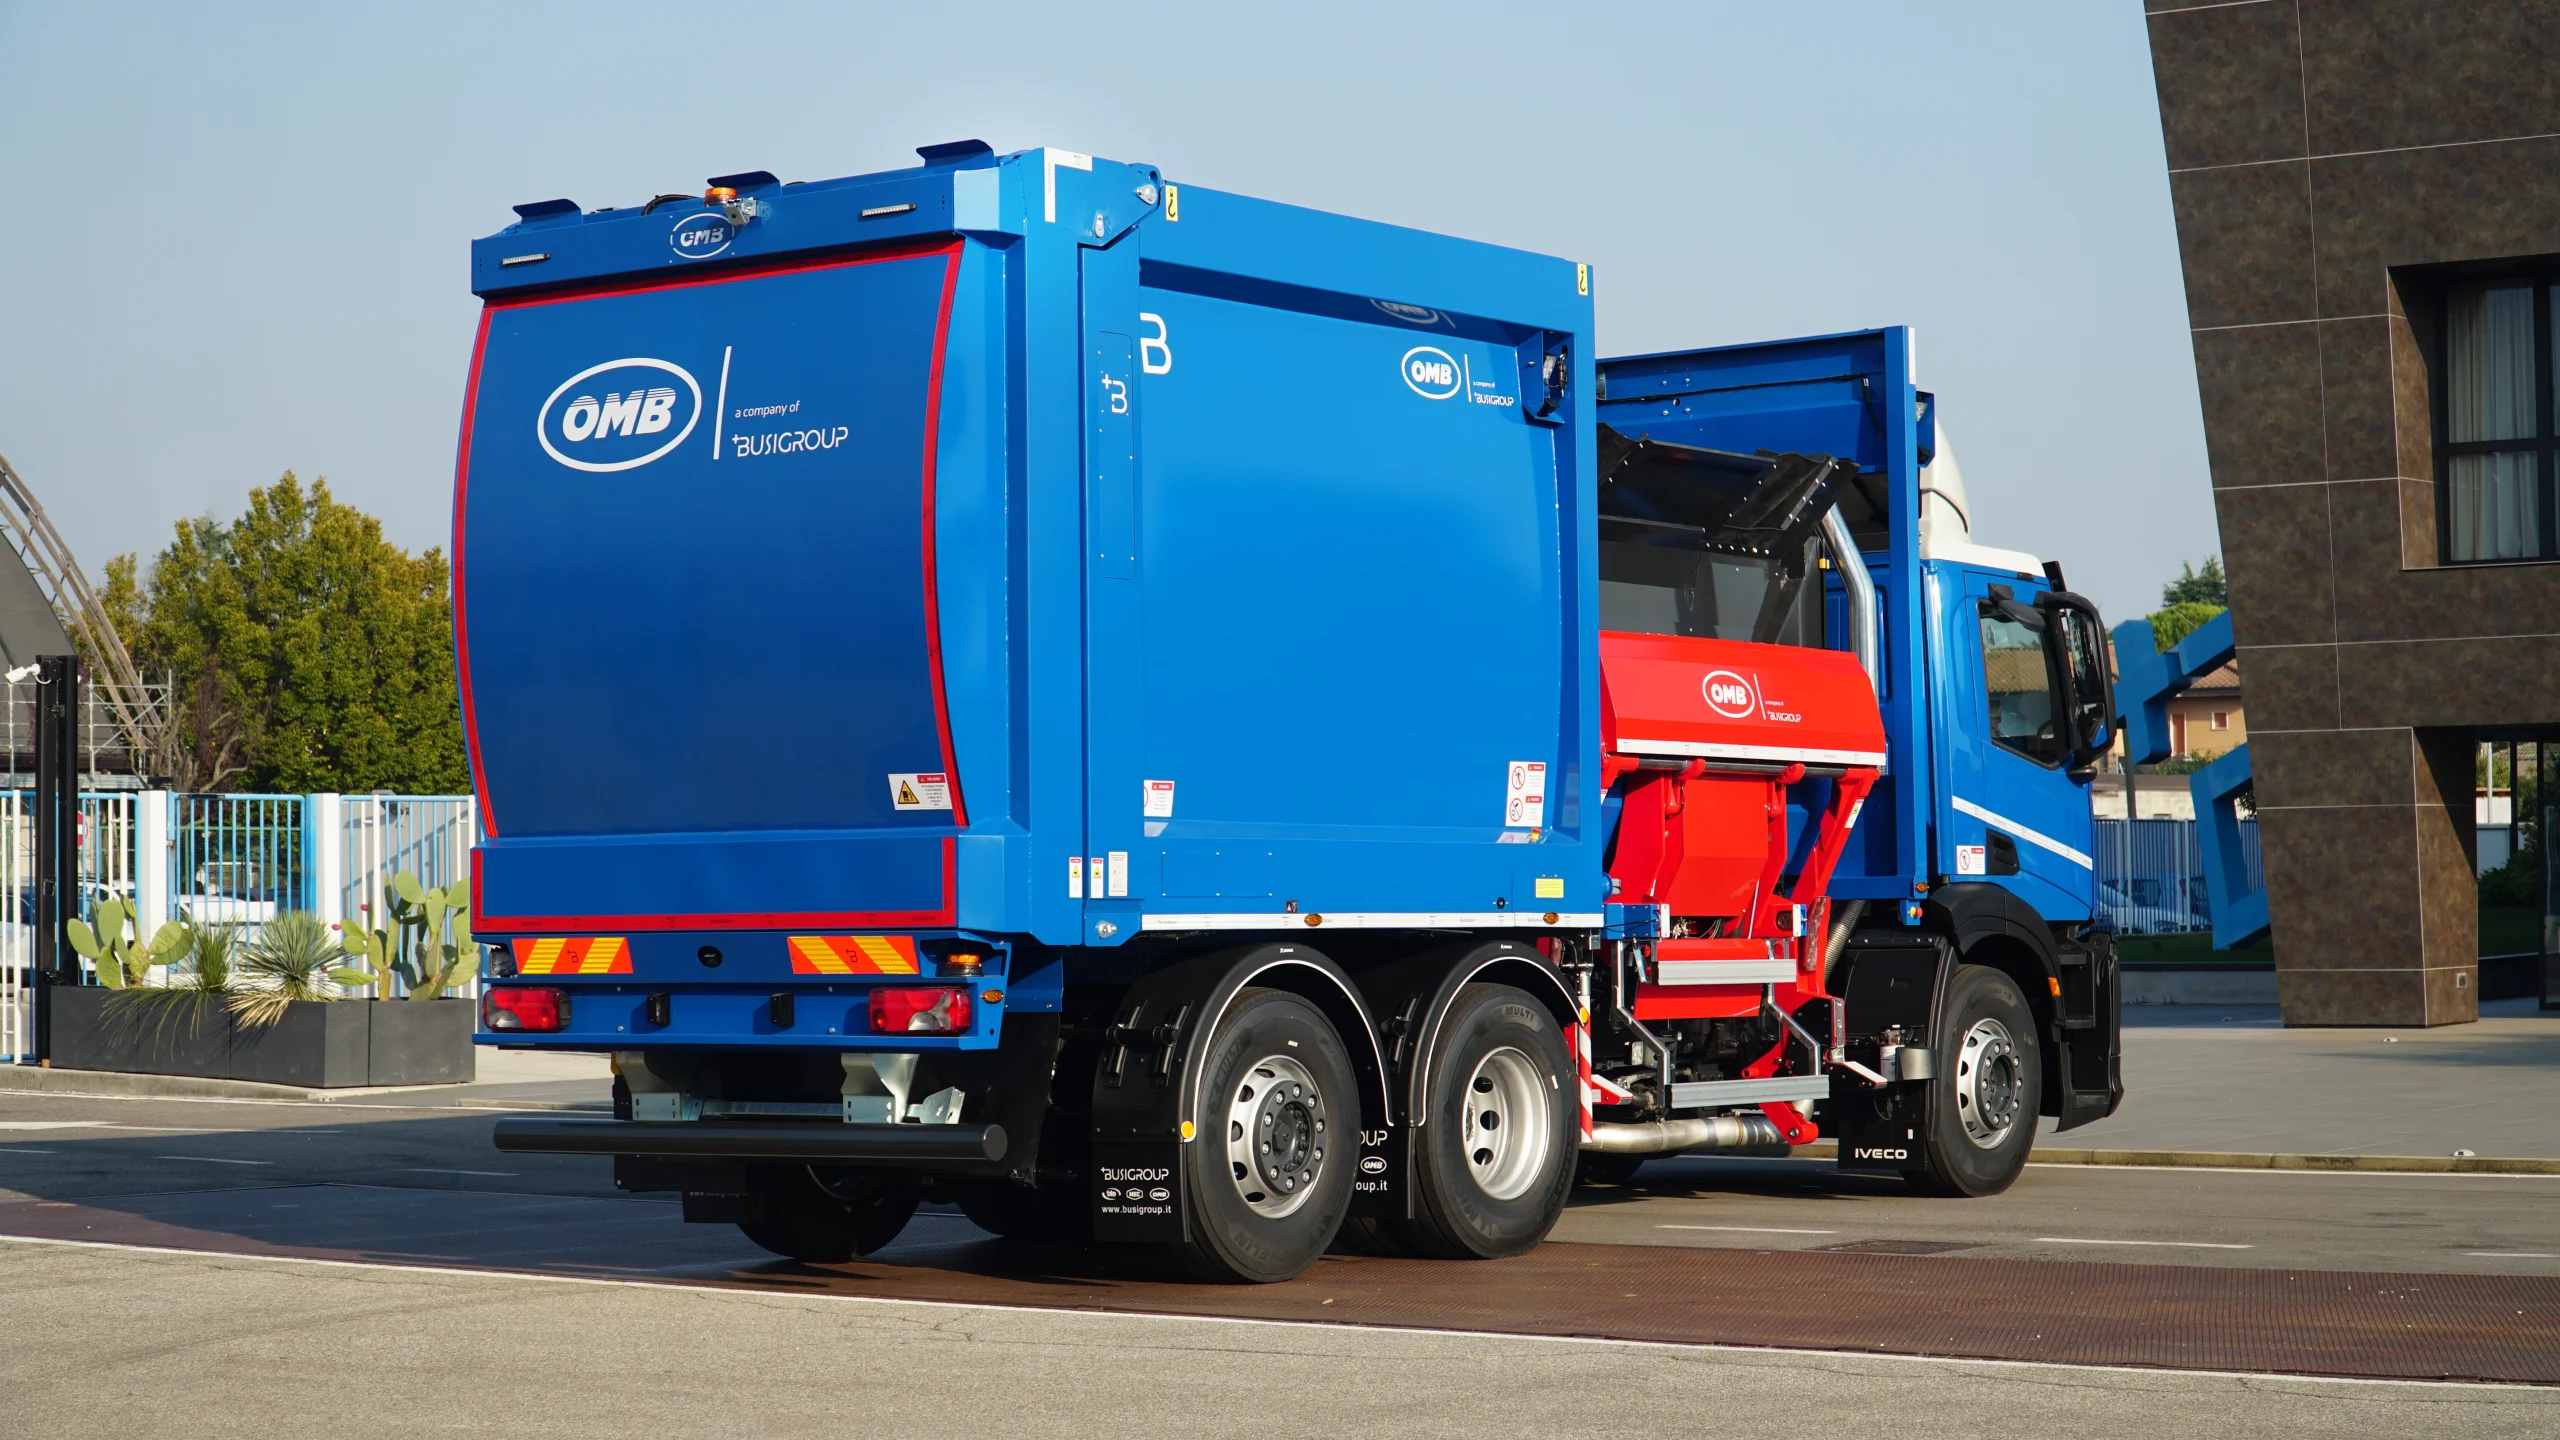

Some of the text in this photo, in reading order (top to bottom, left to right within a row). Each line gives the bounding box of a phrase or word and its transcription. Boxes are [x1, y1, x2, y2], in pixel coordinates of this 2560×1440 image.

[1411, 360, 1453, 386] OMB
[562, 387, 677, 442] OMB
[735, 400, 800, 419] a company of
[1711, 683, 1747, 705] OMB
[1506, 1006, 1534, 1021] MULTI
[1854, 1147, 1908, 1160] IVECO
[1363, 1161, 1383, 1169] OMB
[1101, 1205, 1172, 1216] www.busigroup.it
